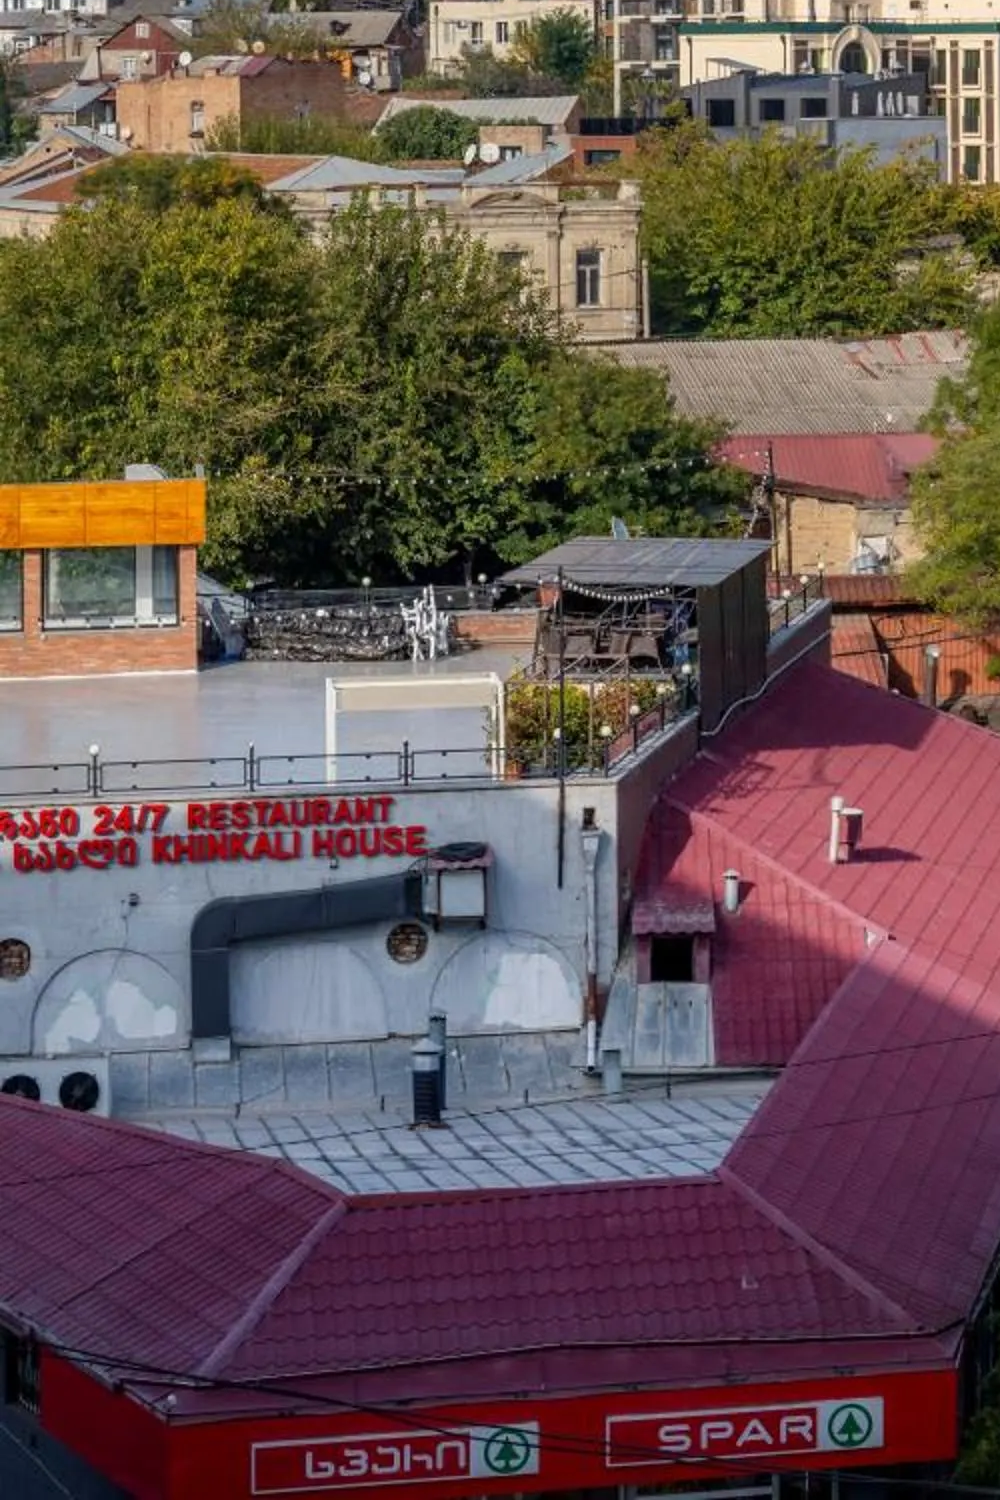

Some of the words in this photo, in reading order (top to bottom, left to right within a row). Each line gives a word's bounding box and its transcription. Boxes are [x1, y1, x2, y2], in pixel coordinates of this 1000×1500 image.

[93, 803, 169, 836] 24/7
[187, 795, 394, 831] RESTAURANT
[13, 837, 138, 872] სახლი
[152, 830, 301, 864] KHINKALI
[313, 825, 427, 858] HOUSE
[657, 1414, 814, 1452] SPAR
